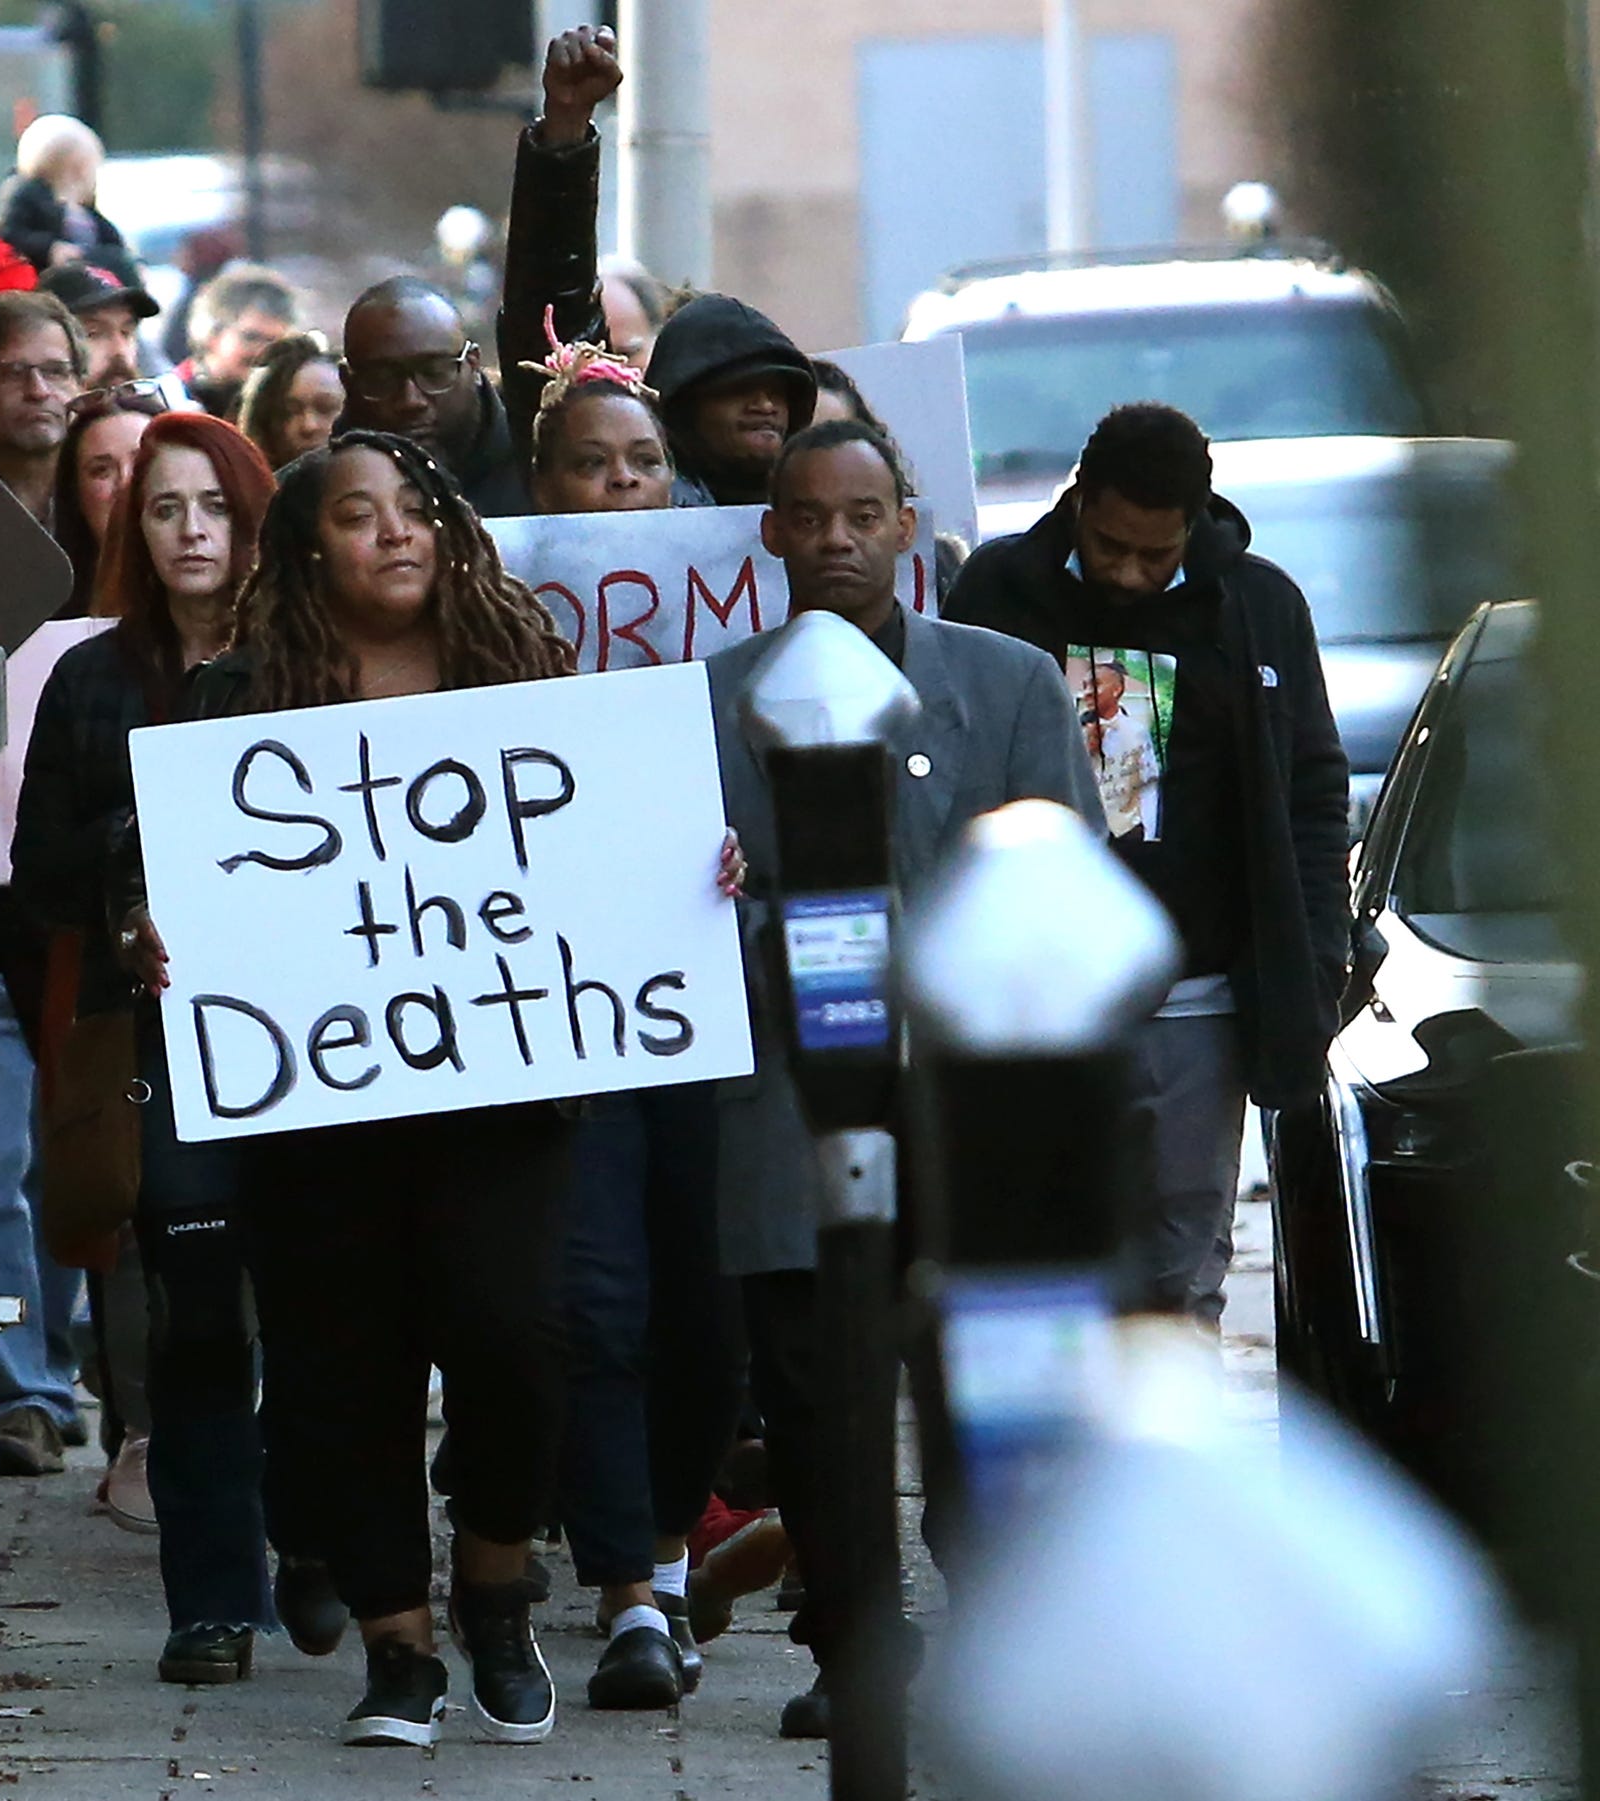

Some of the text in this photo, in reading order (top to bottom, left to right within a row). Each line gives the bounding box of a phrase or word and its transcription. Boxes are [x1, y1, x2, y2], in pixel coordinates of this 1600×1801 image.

[216, 730, 575, 875] Stop
[343, 862, 534, 968] the
[189, 931, 694, 1119] Deaths
